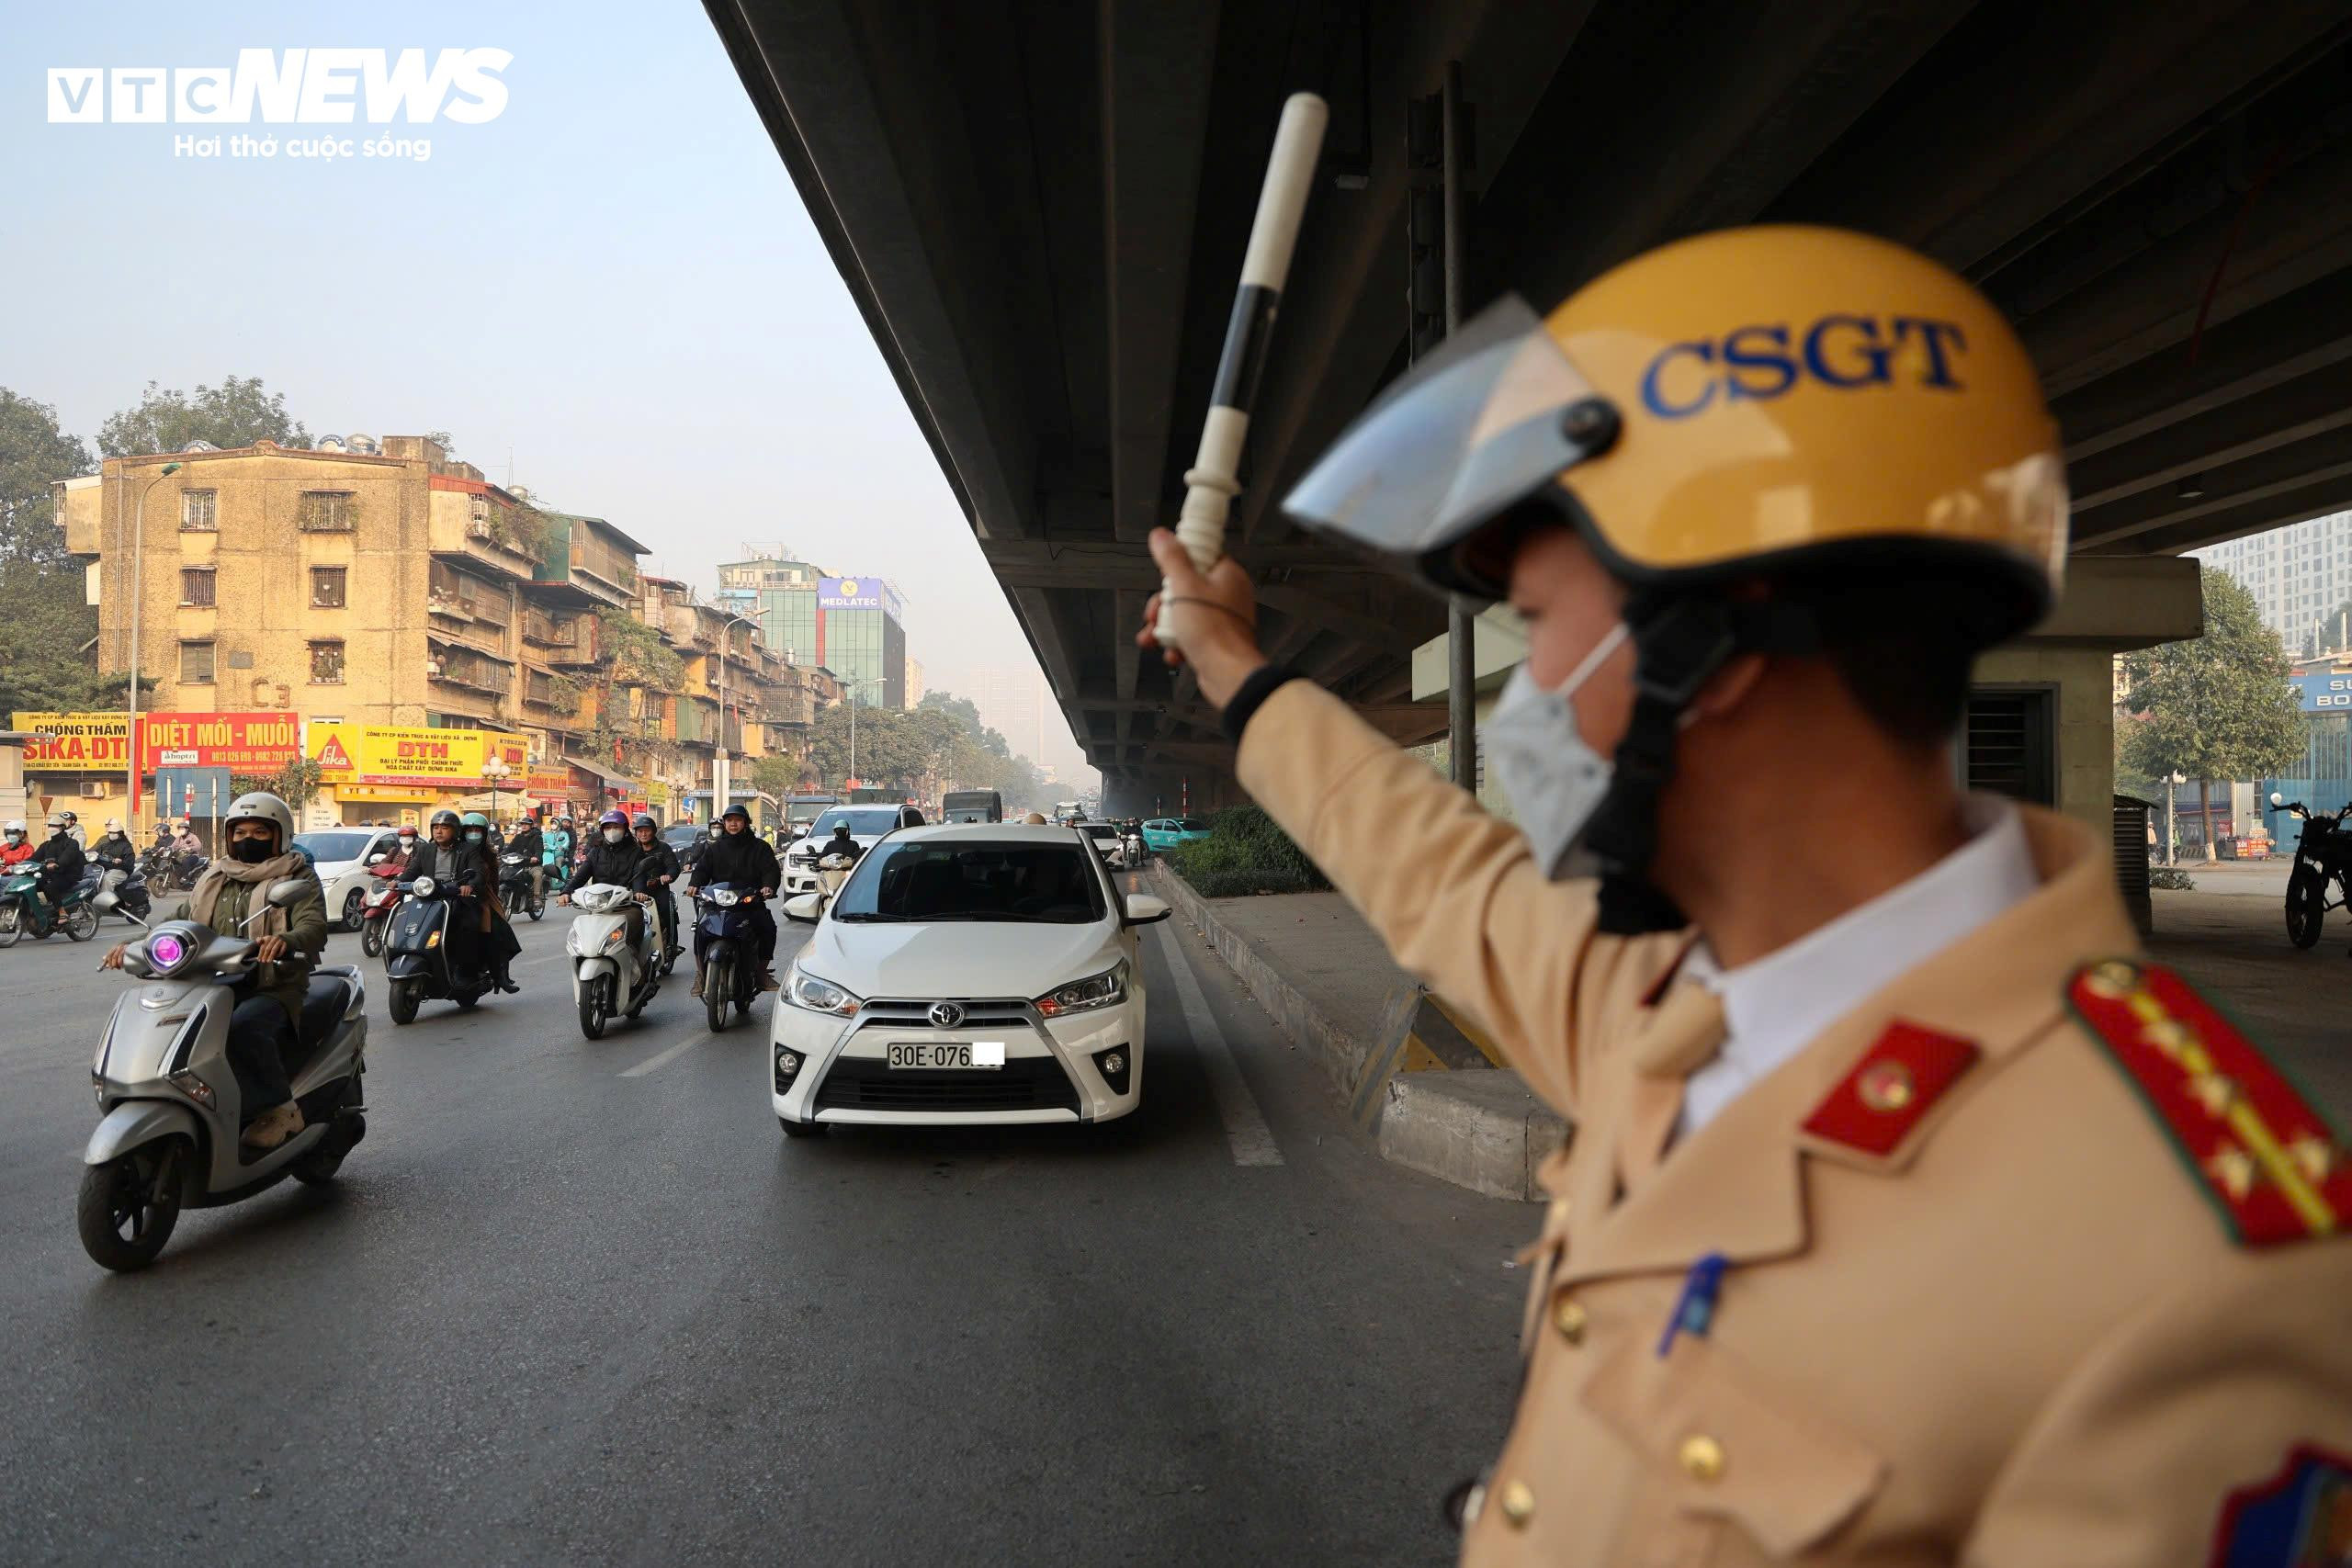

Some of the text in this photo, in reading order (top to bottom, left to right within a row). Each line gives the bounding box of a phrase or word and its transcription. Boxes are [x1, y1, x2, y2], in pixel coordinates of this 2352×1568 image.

[1639, 313, 1967, 421] CSGT
[820, 597, 877, 606] MEDLATEC
[35, 721, 126, 736] CHỐNG THẤM
[150, 718, 191, 752] DIỆT
[197, 716, 232, 747] MỐI
[246, 715, 295, 747] MUỖI
[317, 745, 347, 765] Sika
[398, 741, 448, 758] DTH
[891, 1045, 998, 1067] 30E-076.
